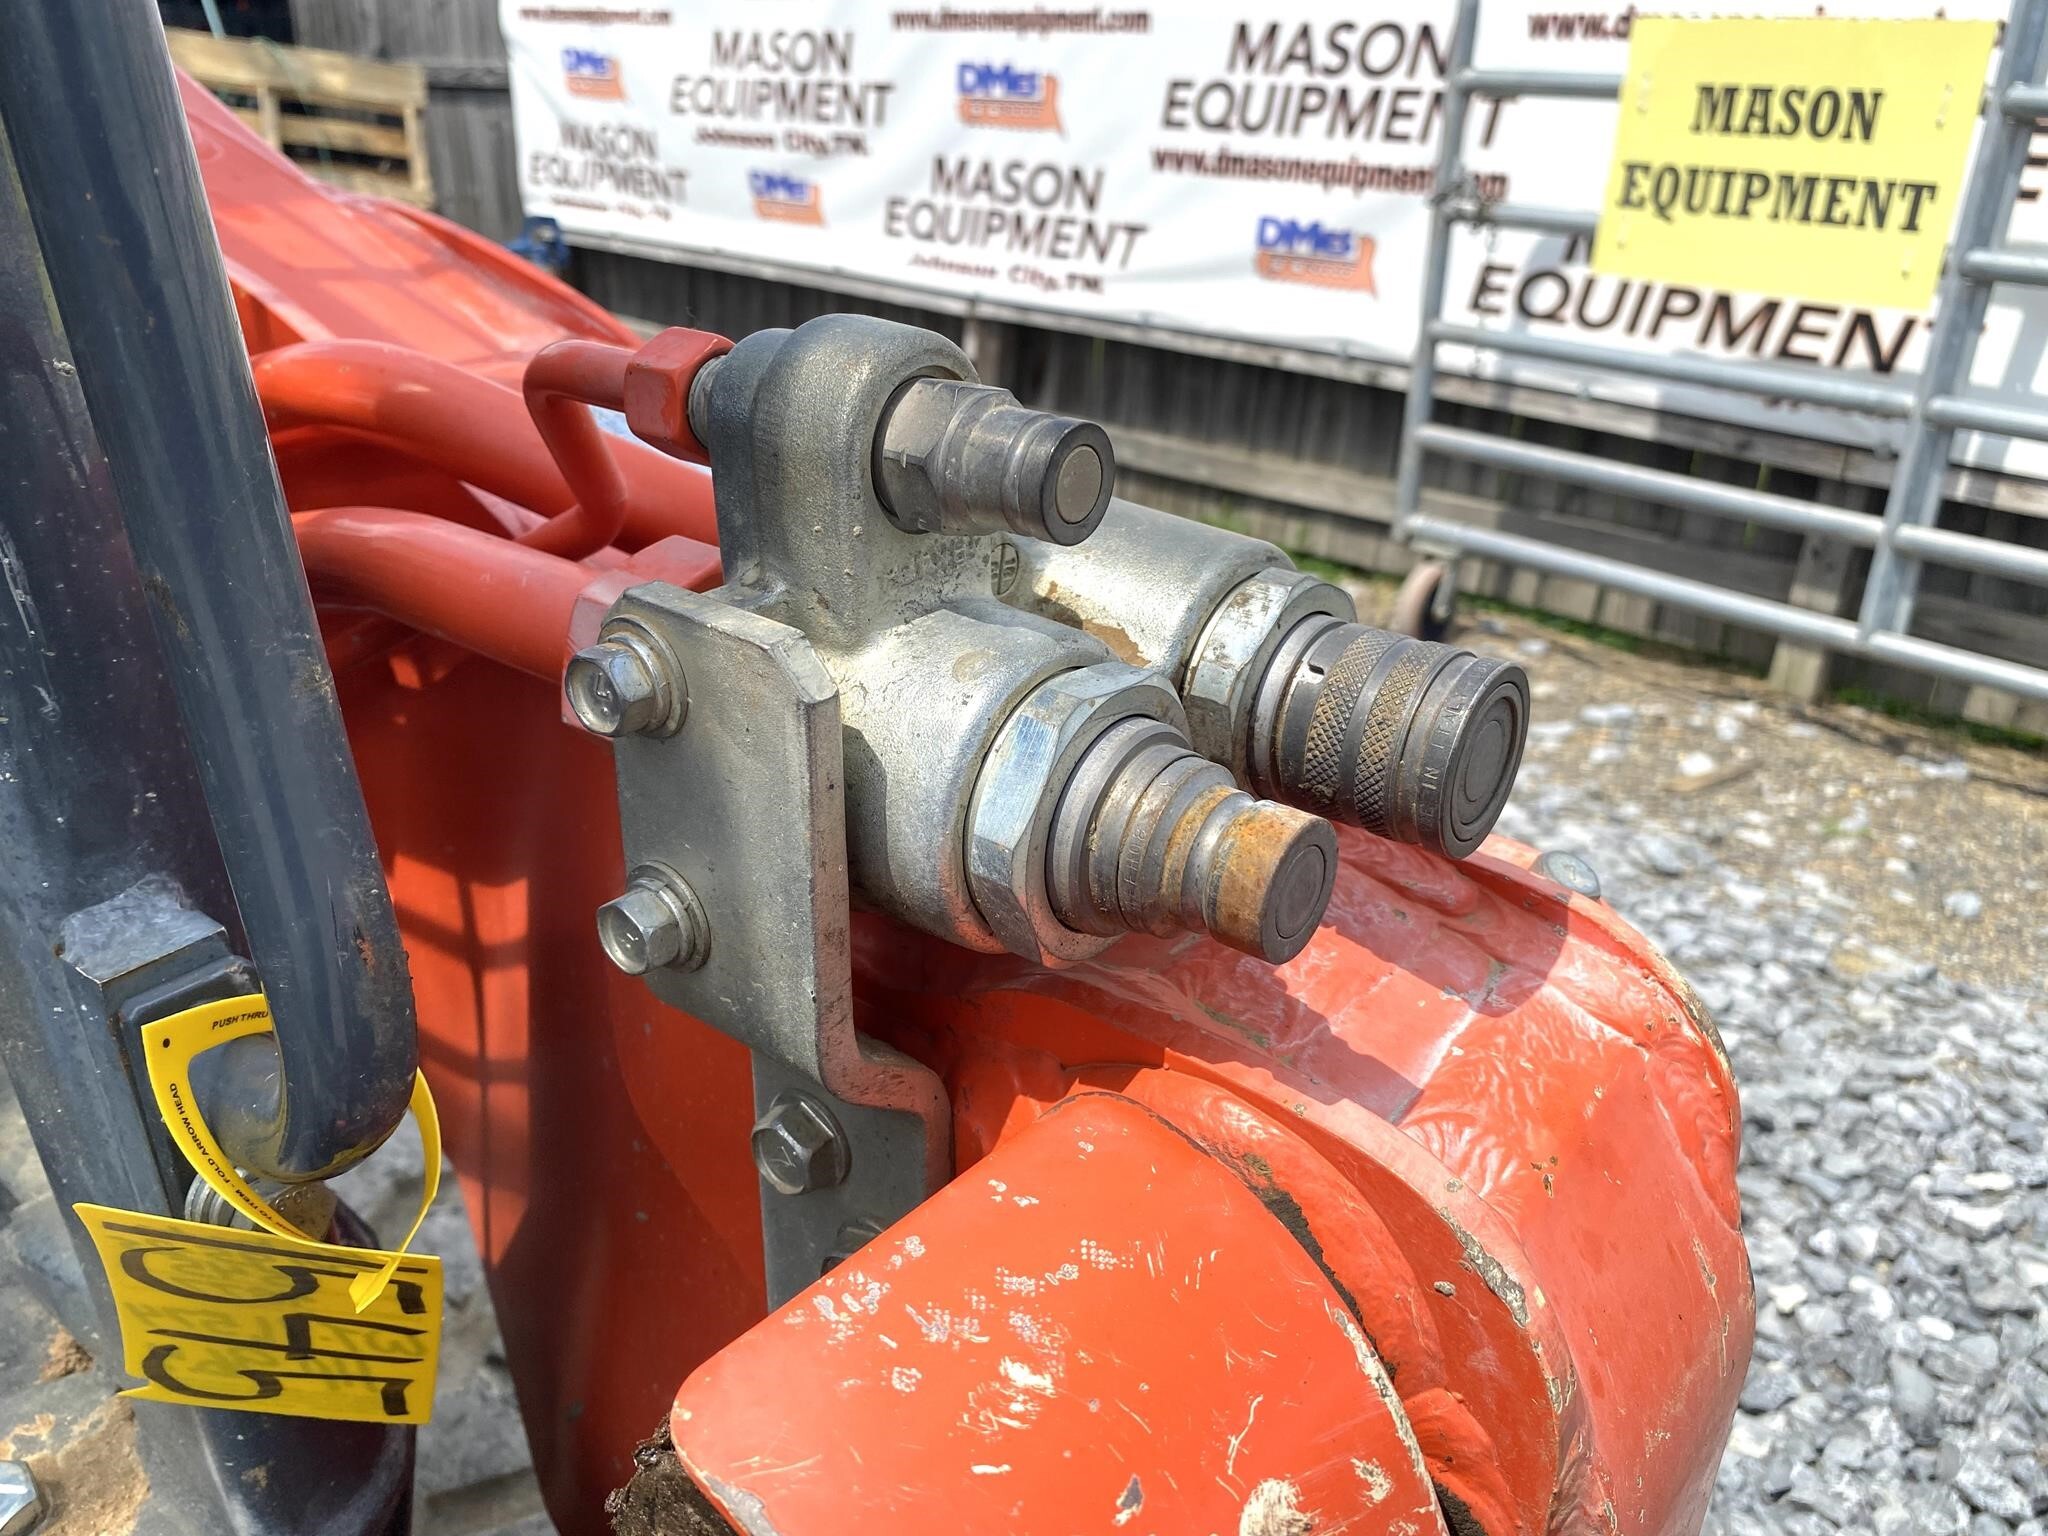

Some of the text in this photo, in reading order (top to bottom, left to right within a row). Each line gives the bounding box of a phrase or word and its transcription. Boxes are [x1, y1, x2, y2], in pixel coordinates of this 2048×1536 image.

[711, 28, 853, 75] MASON
[669, 73, 894, 128] EQUIPMENT
[1689, 84, 1883, 142] MASON
[931, 156, 1104, 213] MASON
[1617, 161, 1938, 234] EQUIPMENT
[885, 196, 1148, 270] EQUIPMENT
[1469, 263, 1937, 377] EQUIPMEN
[211, 1010, 269, 1030] PUSH THRU
[169, 1082, 186, 1115] HEAD
[181, 1116, 209, 1156] ARROW
[207, 1157, 231, 1185] FOLD
[234, 1188, 260, 1213] ITEM
